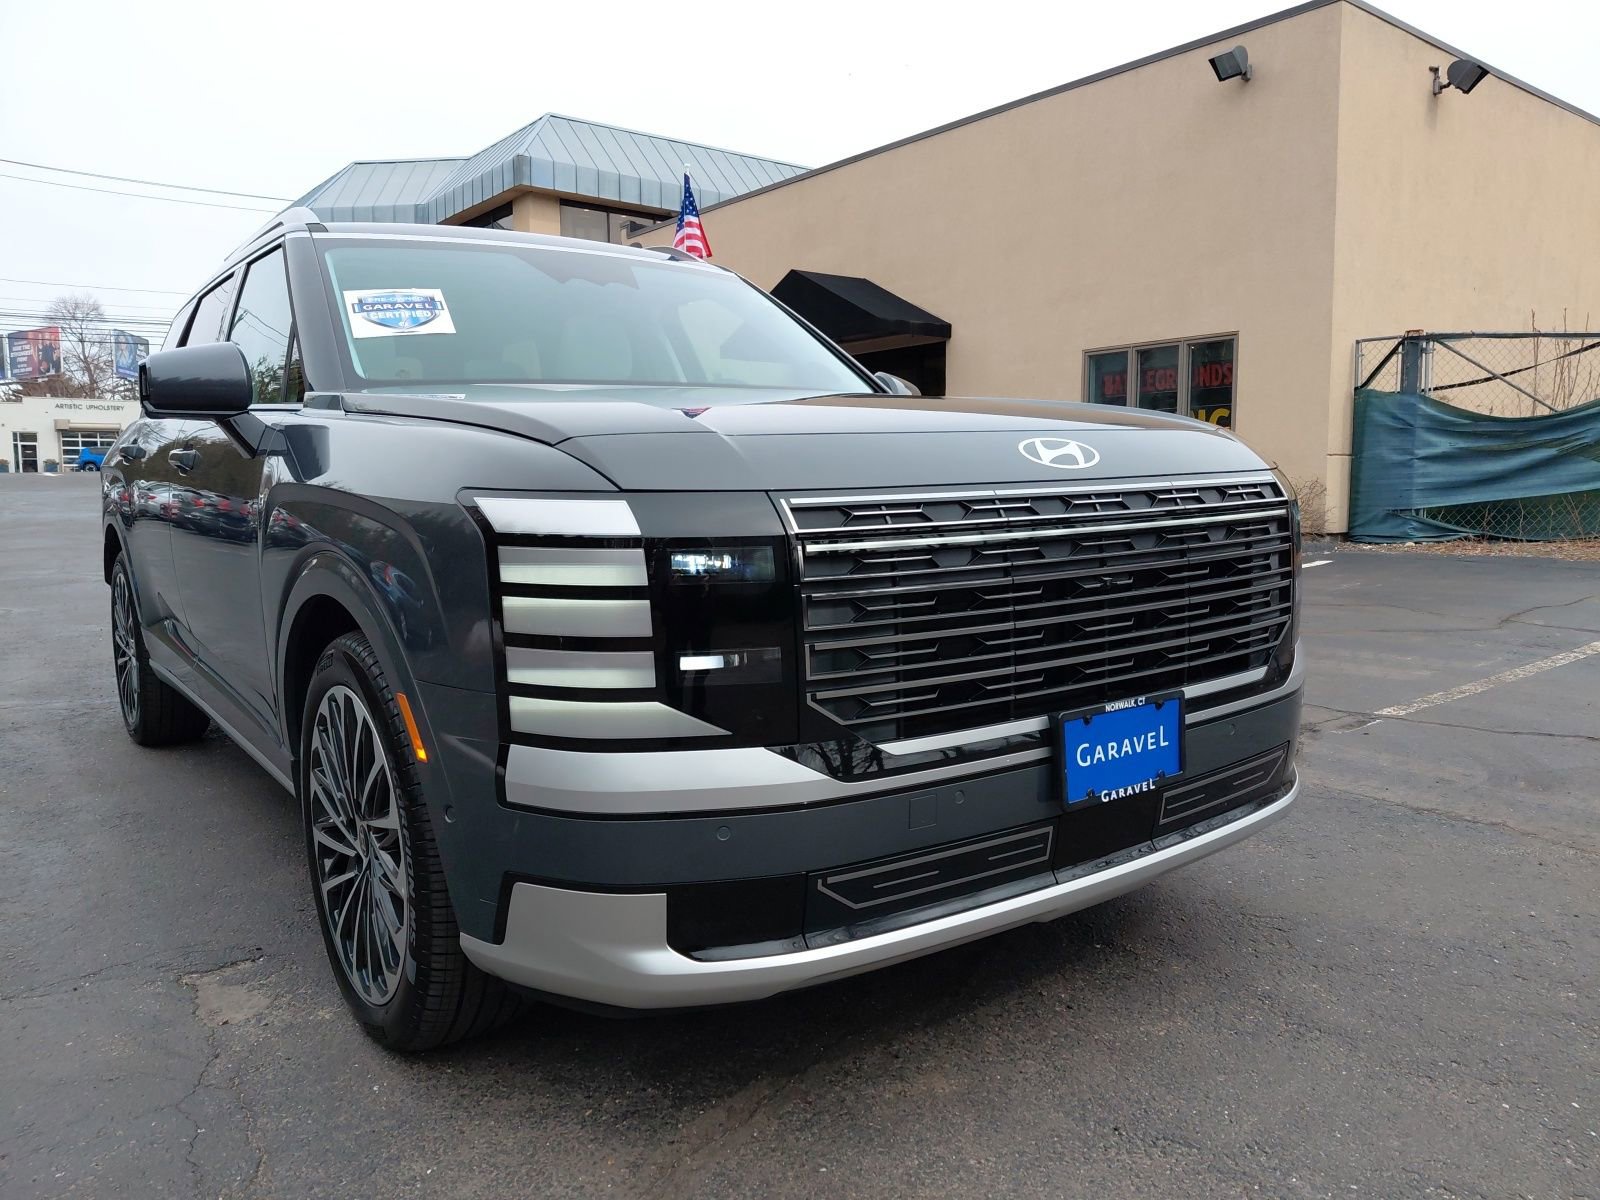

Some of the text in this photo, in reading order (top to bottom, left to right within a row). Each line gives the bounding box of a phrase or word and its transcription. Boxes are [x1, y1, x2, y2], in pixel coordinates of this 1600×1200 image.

[362, 302, 433, 310] GARAVEL
[369, 310, 431, 319] CERTIFIED
[1105, 697, 1145, 712] NORWALK, CT
[1076, 725, 1169, 767] GARAVEL
[1101, 778, 1156, 802] GARAVEL
